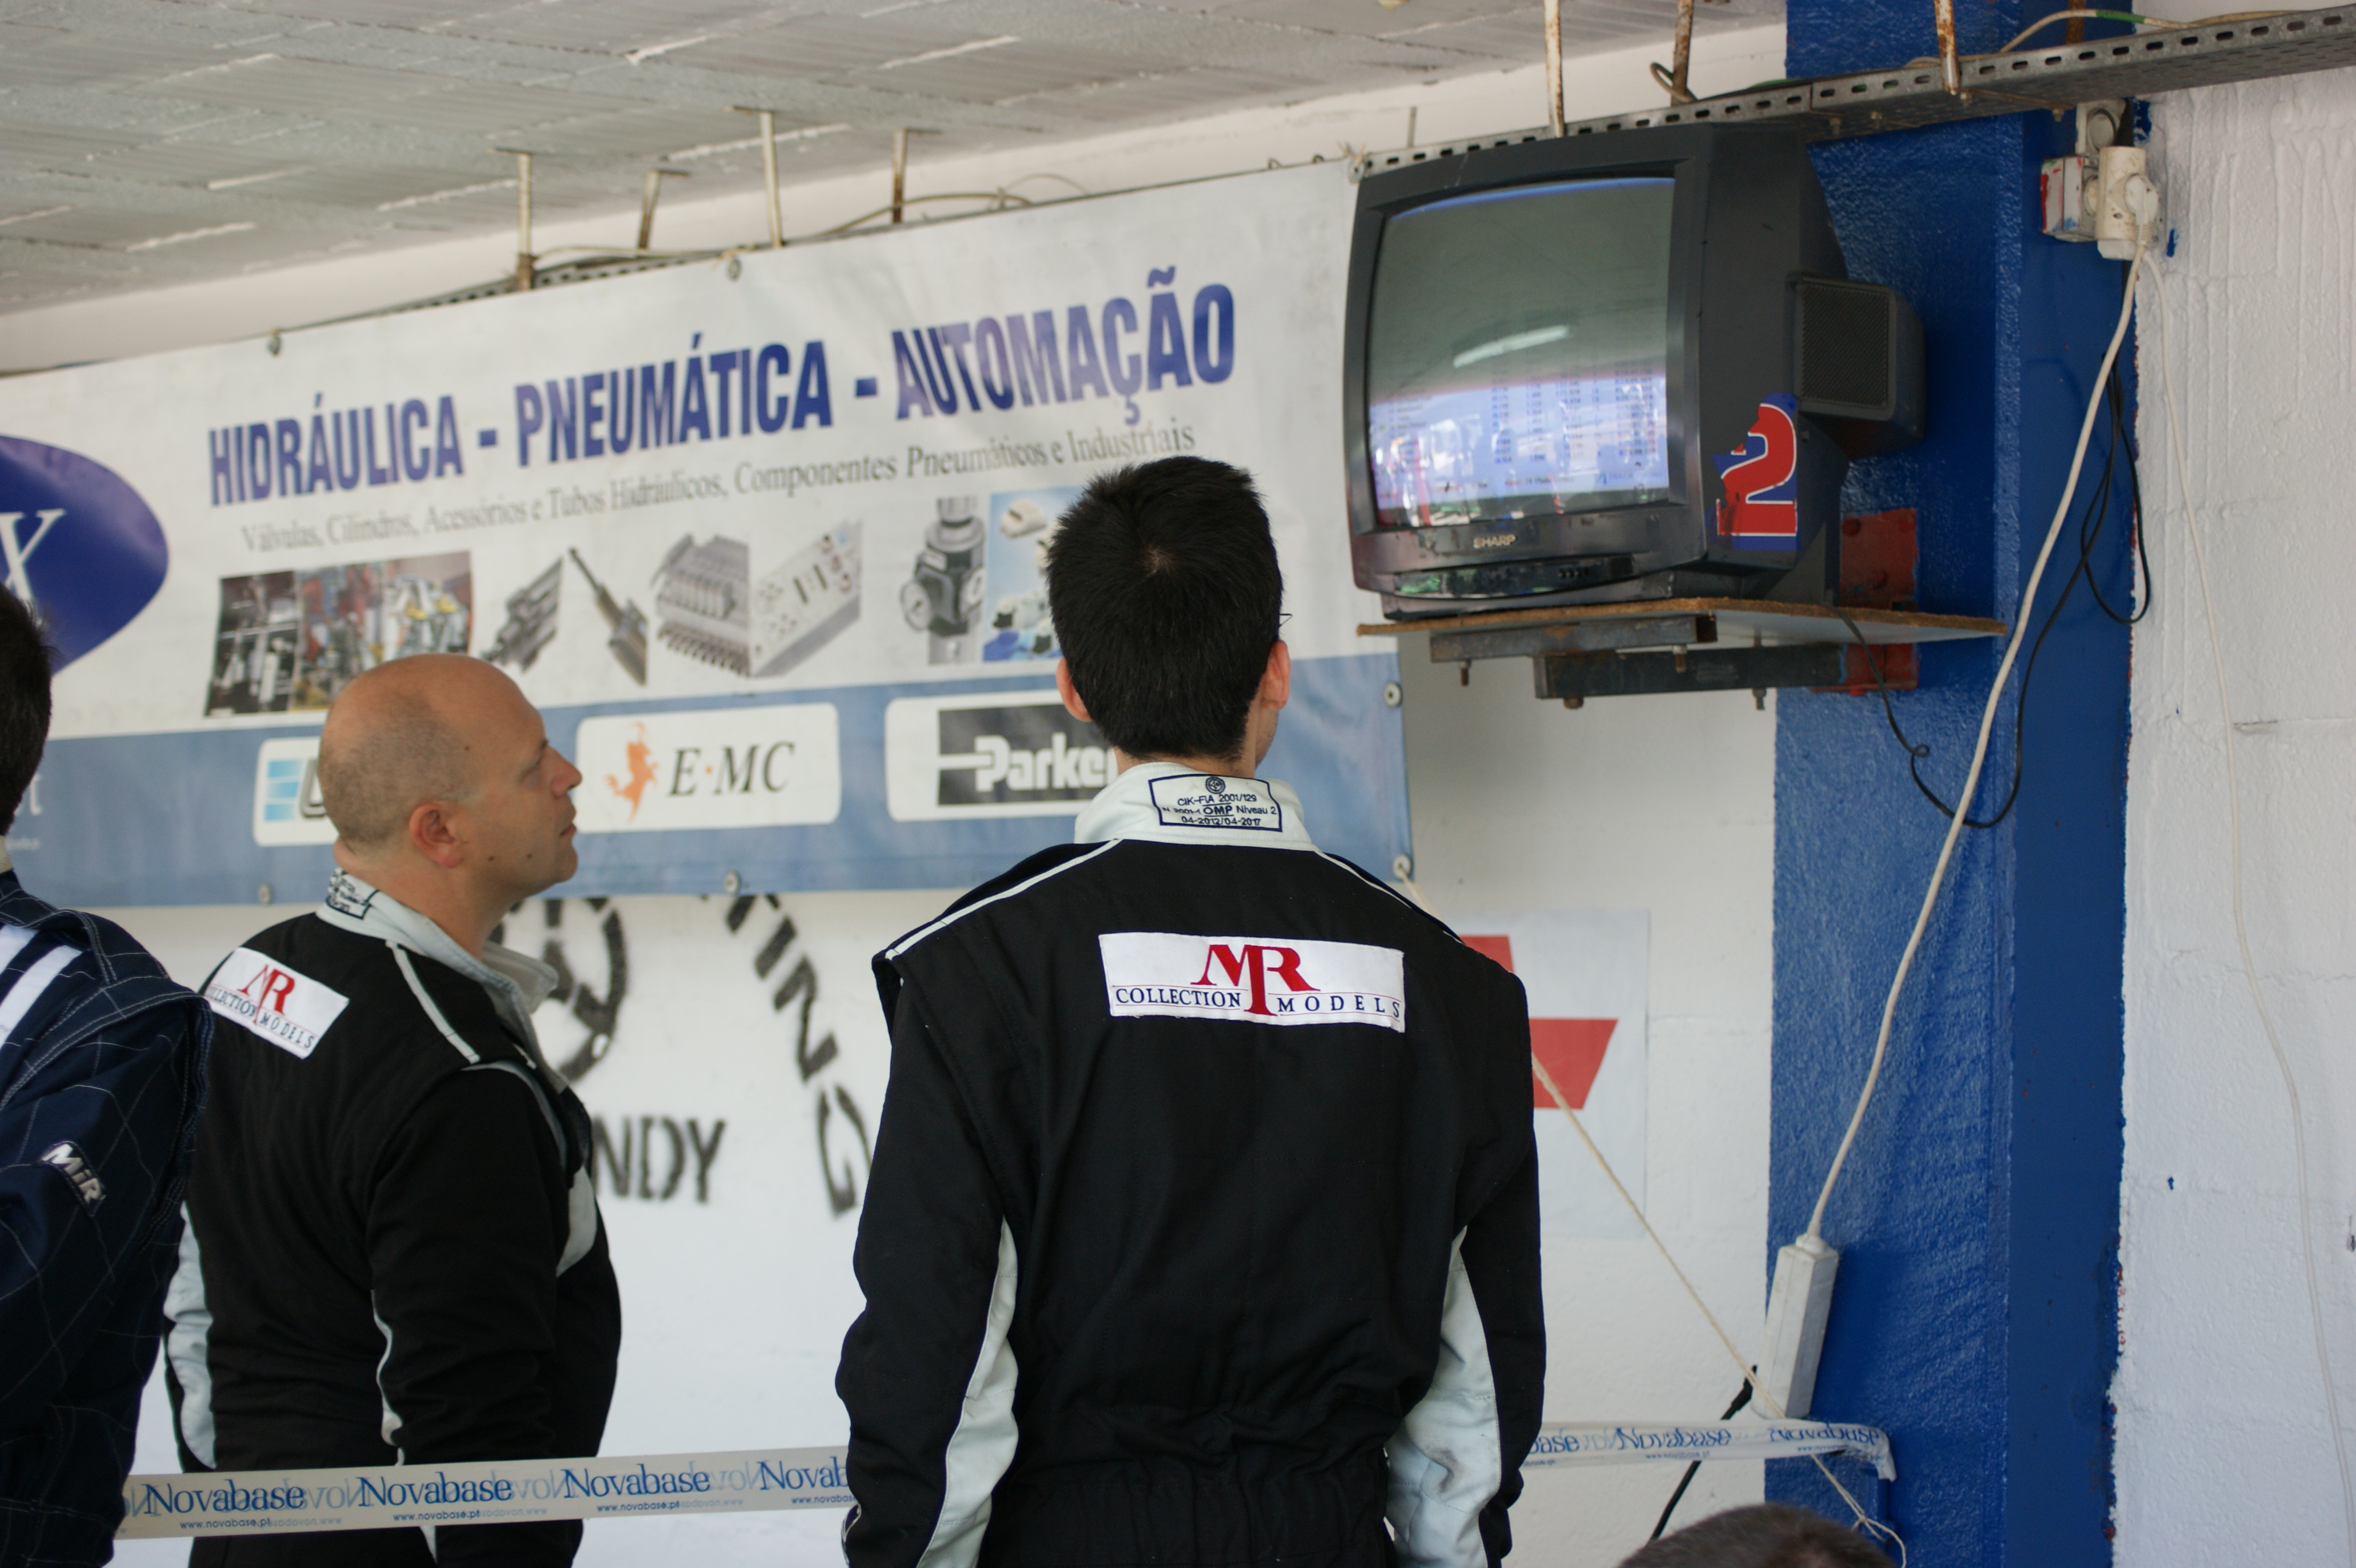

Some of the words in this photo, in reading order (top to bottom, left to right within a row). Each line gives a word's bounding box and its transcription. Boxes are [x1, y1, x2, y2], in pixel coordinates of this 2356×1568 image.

[208, 393, 464, 507] HIDRÁULICA
[514, 333, 832, 467] PNEUMÁTICA
[892, 265, 1235, 425] AUTOMAÇÃO
[547, 484, 605, 519] Tubos
[734, 456, 897, 498] Componentes
[1051, 441, 1064, 463] e
[1066, 417, 1195, 462] Industriais
[1474, 534, 1517, 548] SHARP
[1177, 796, 1215, 806] CIK-FIA
[1219, 794, 1257, 802] 2001/129
[1203, 805, 1233, 815] OMP
[1236, 805, 1268, 814] Niveau
[1270, 806, 1278, 815] 2
[1115, 988, 1242, 1008] COLLECTION
[1277, 995, 1401, 1018] MODELS
[1616, 1426, 1732, 1450] Novabase
[357, 1471, 513, 1507] Novabase
[561, 1463, 711, 1499] Novabase
[142, 1479, 304, 1515] Novabase
[597, 1500, 680, 1513] www.novabase.pt
[180, 1518, 271, 1530] www.novabase.pt
[393, 1510, 481, 1522] www.novabase.pt
